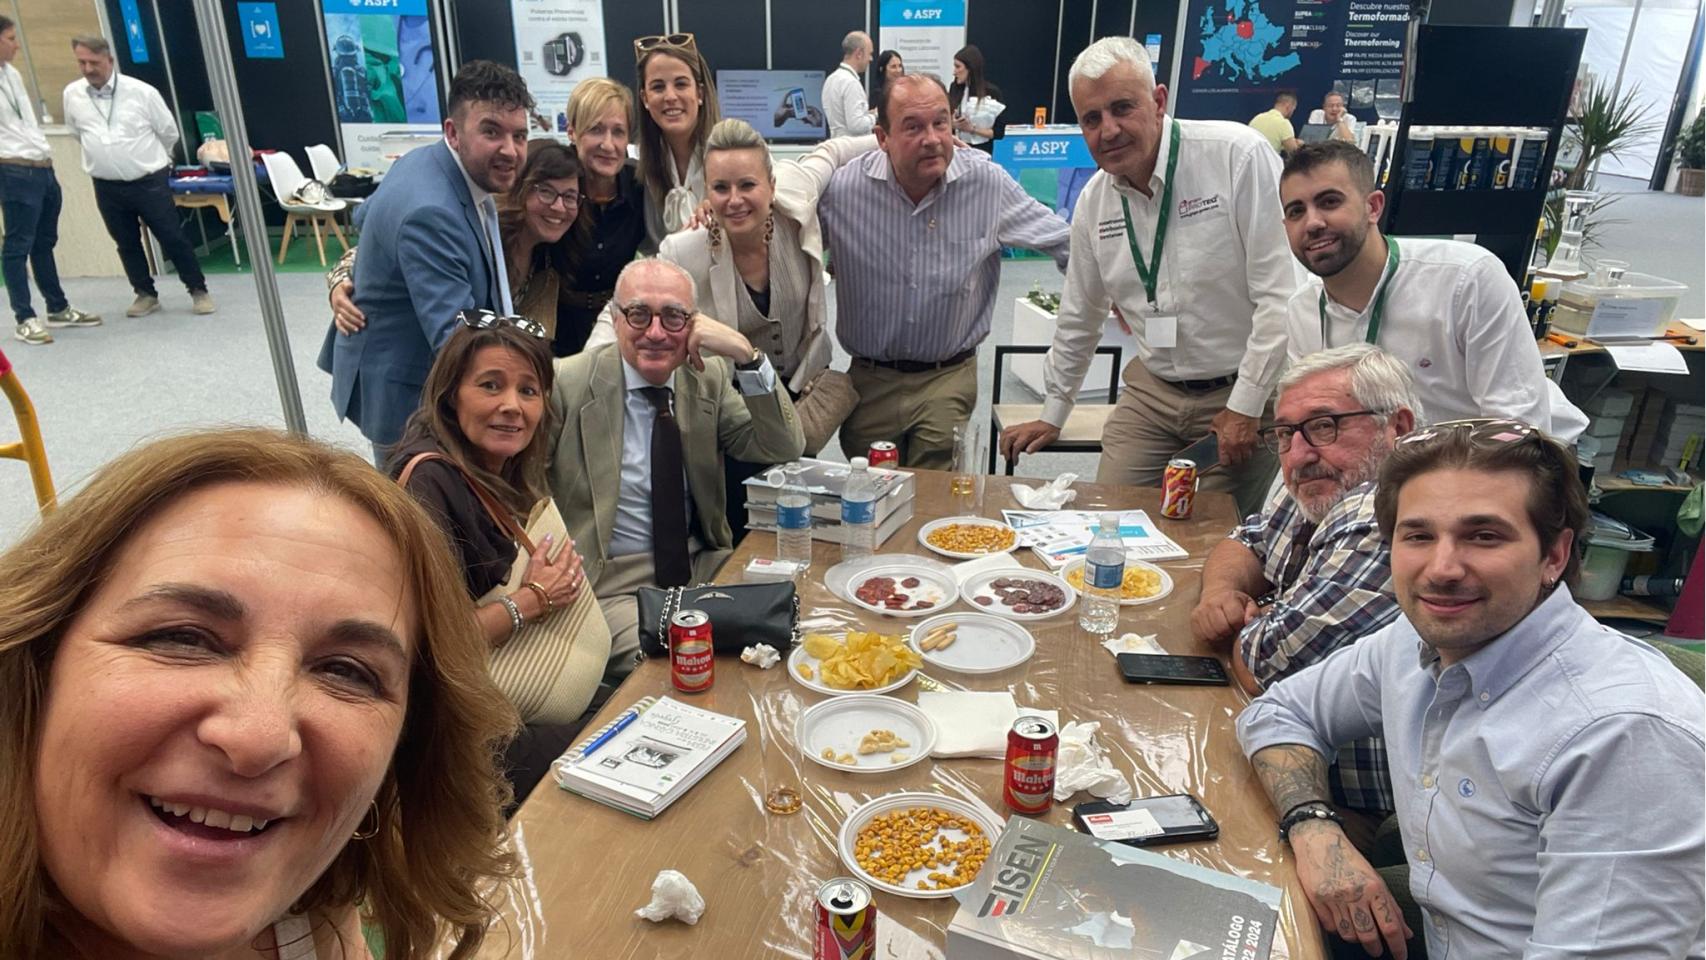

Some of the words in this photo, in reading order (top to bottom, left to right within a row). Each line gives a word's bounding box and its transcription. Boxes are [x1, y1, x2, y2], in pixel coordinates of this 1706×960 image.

[1350, 2, 1382, 10] Descubre
[914, 9, 942, 19] ASPY
[1344, 38, 1400, 48] Thermoforming
[1029, 141, 1070, 155] ASPY
[676, 654, 712, 666] Mahou
